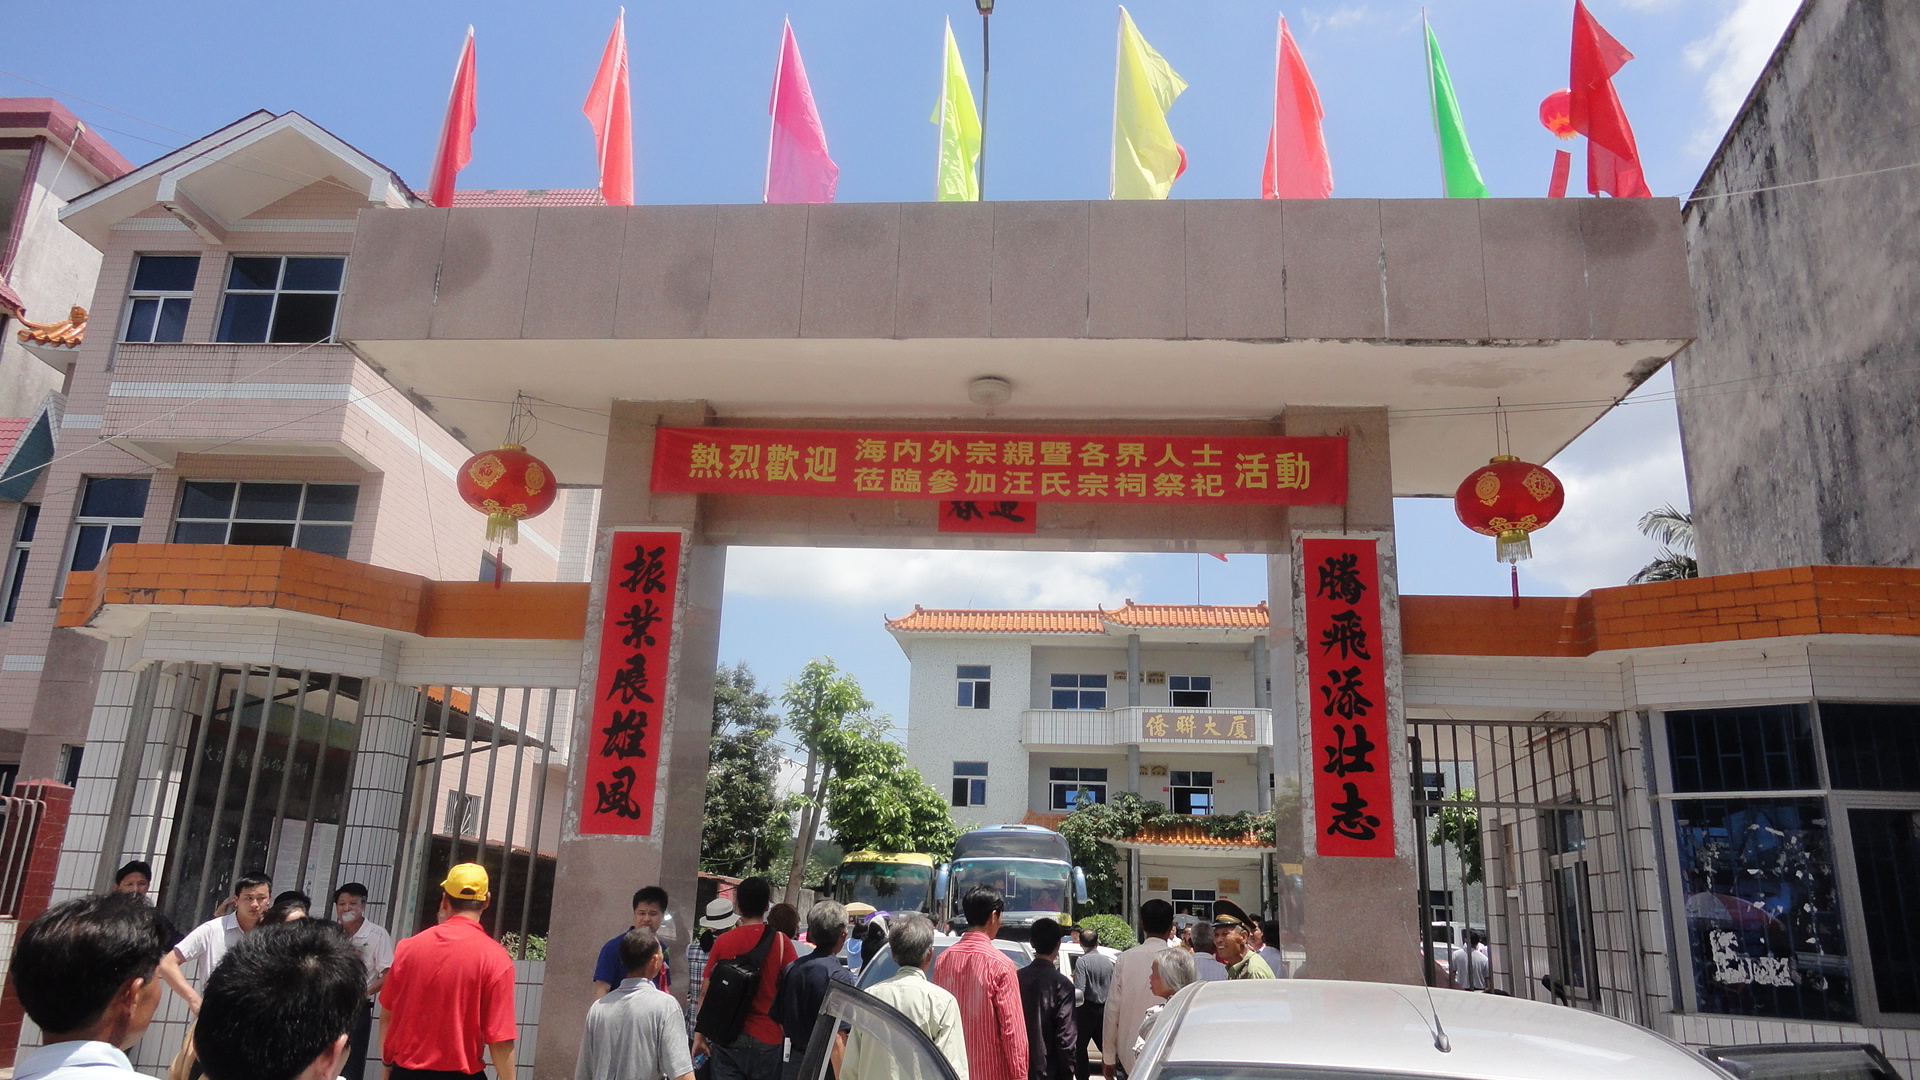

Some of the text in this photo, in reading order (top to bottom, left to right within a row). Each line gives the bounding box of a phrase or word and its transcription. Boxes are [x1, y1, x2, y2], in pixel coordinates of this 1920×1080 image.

[689, 442, 838, 482] 熱烈歡迎
[1234, 452, 1310, 490] 活動
